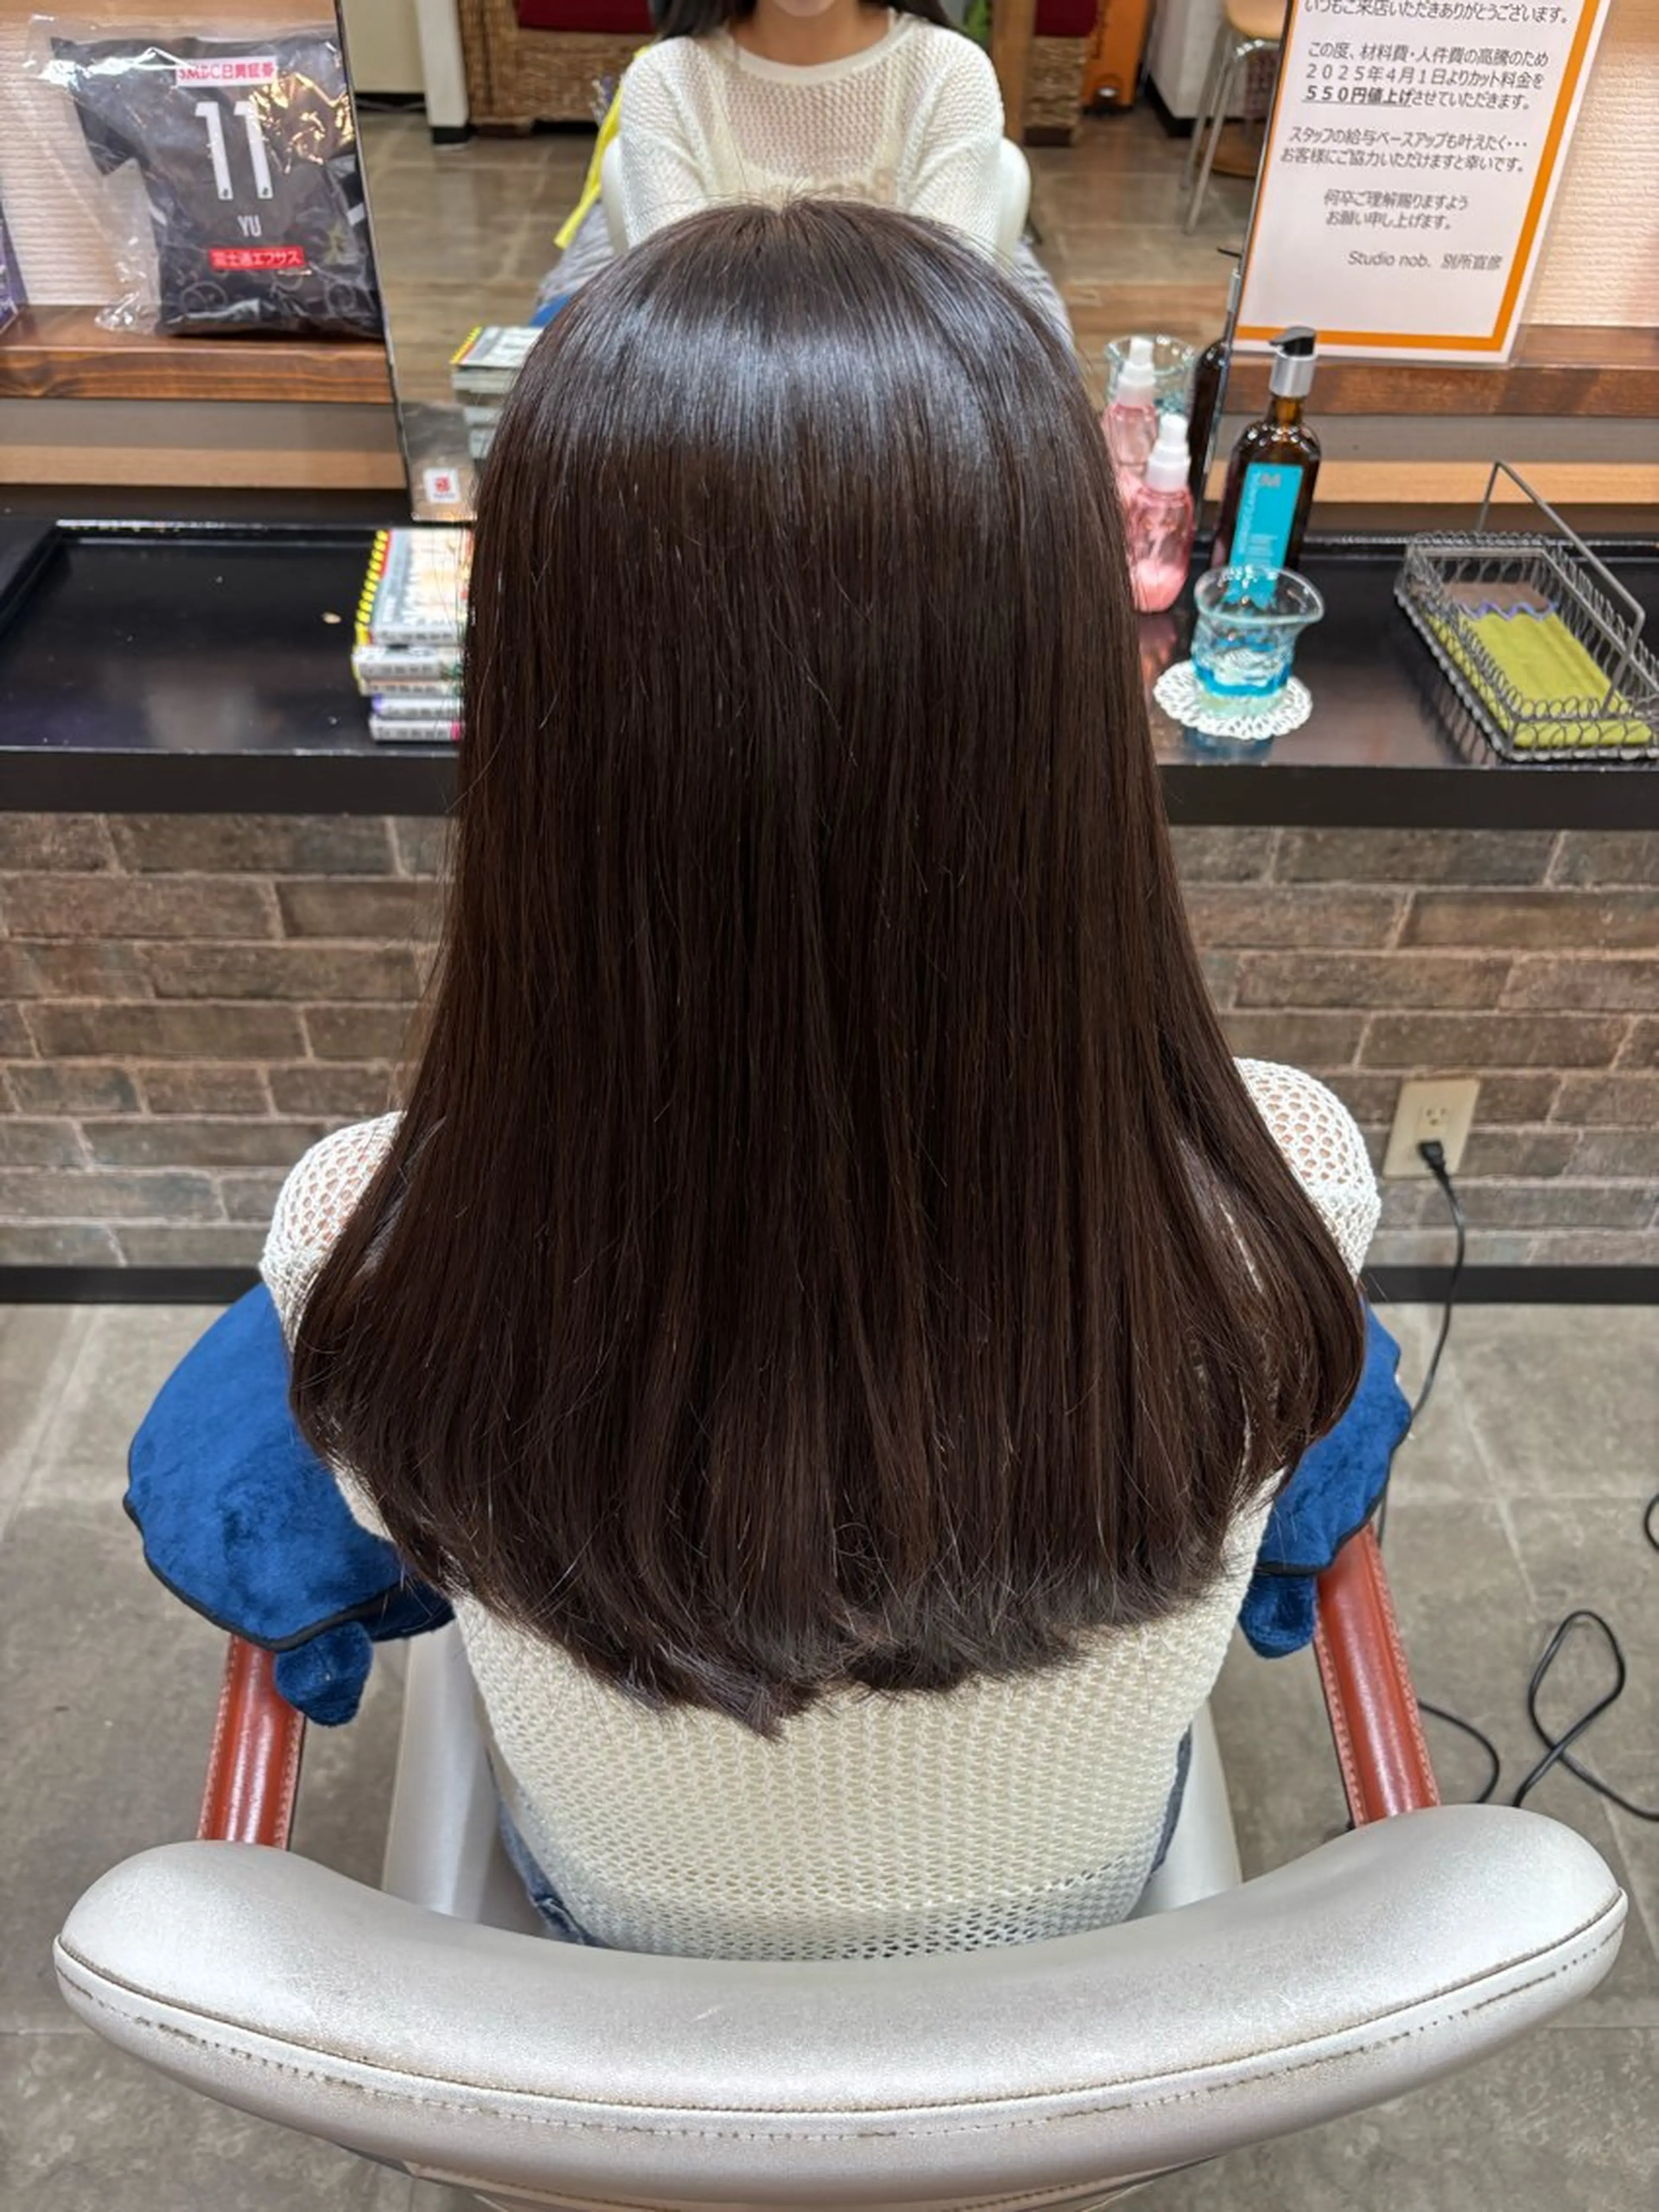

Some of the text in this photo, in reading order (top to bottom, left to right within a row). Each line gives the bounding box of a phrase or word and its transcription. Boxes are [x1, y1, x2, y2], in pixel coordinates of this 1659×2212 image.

[195, 101, 273, 200] 11
[237, 215, 262, 237] YU
[1348, 251, 1395, 266] Studio
[1399, 252, 1431, 268] nob.
